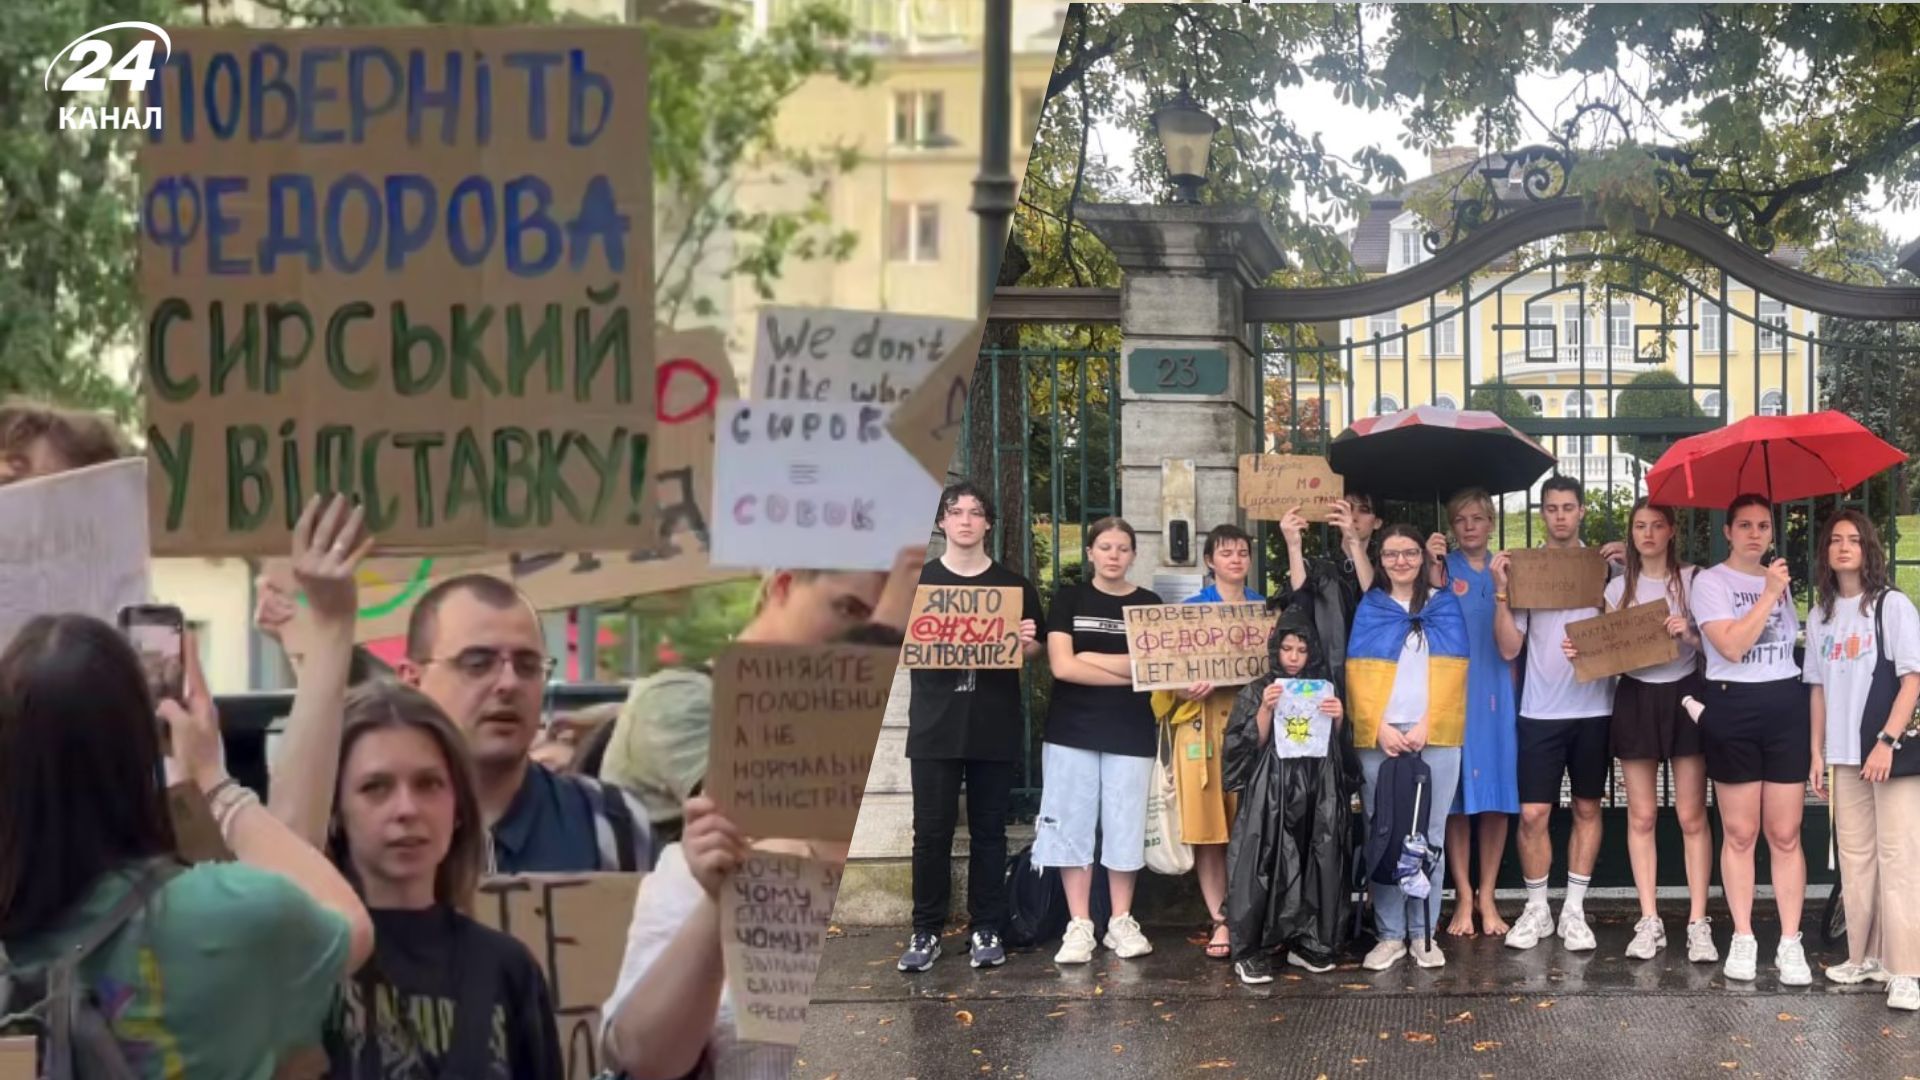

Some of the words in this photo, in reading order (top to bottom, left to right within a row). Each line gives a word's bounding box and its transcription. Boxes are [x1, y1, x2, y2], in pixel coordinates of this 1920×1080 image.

[143, 173, 630, 277] ФЕДОРОВА
[149, 283, 634, 402] СИРСЬКИЙ
[766, 315, 835, 360] We
[850, 316, 946, 363] don't
[765, 364, 832, 401] like
[1157, 355, 1199, 388] 23
[147, 421, 194, 533] У
[733, 495, 876, 532] СОВОК
[922, 588, 1002, 614] ЯКОГО
[736, 652, 874, 684] МІНЯЙТЕ
[1135, 662, 1175, 685] LET
[1187, 656, 1226, 681] HIM
[734, 725, 749, 747] А
[763, 723, 795, 747] НЕ
[735, 882, 812, 909] ЧОМУ
